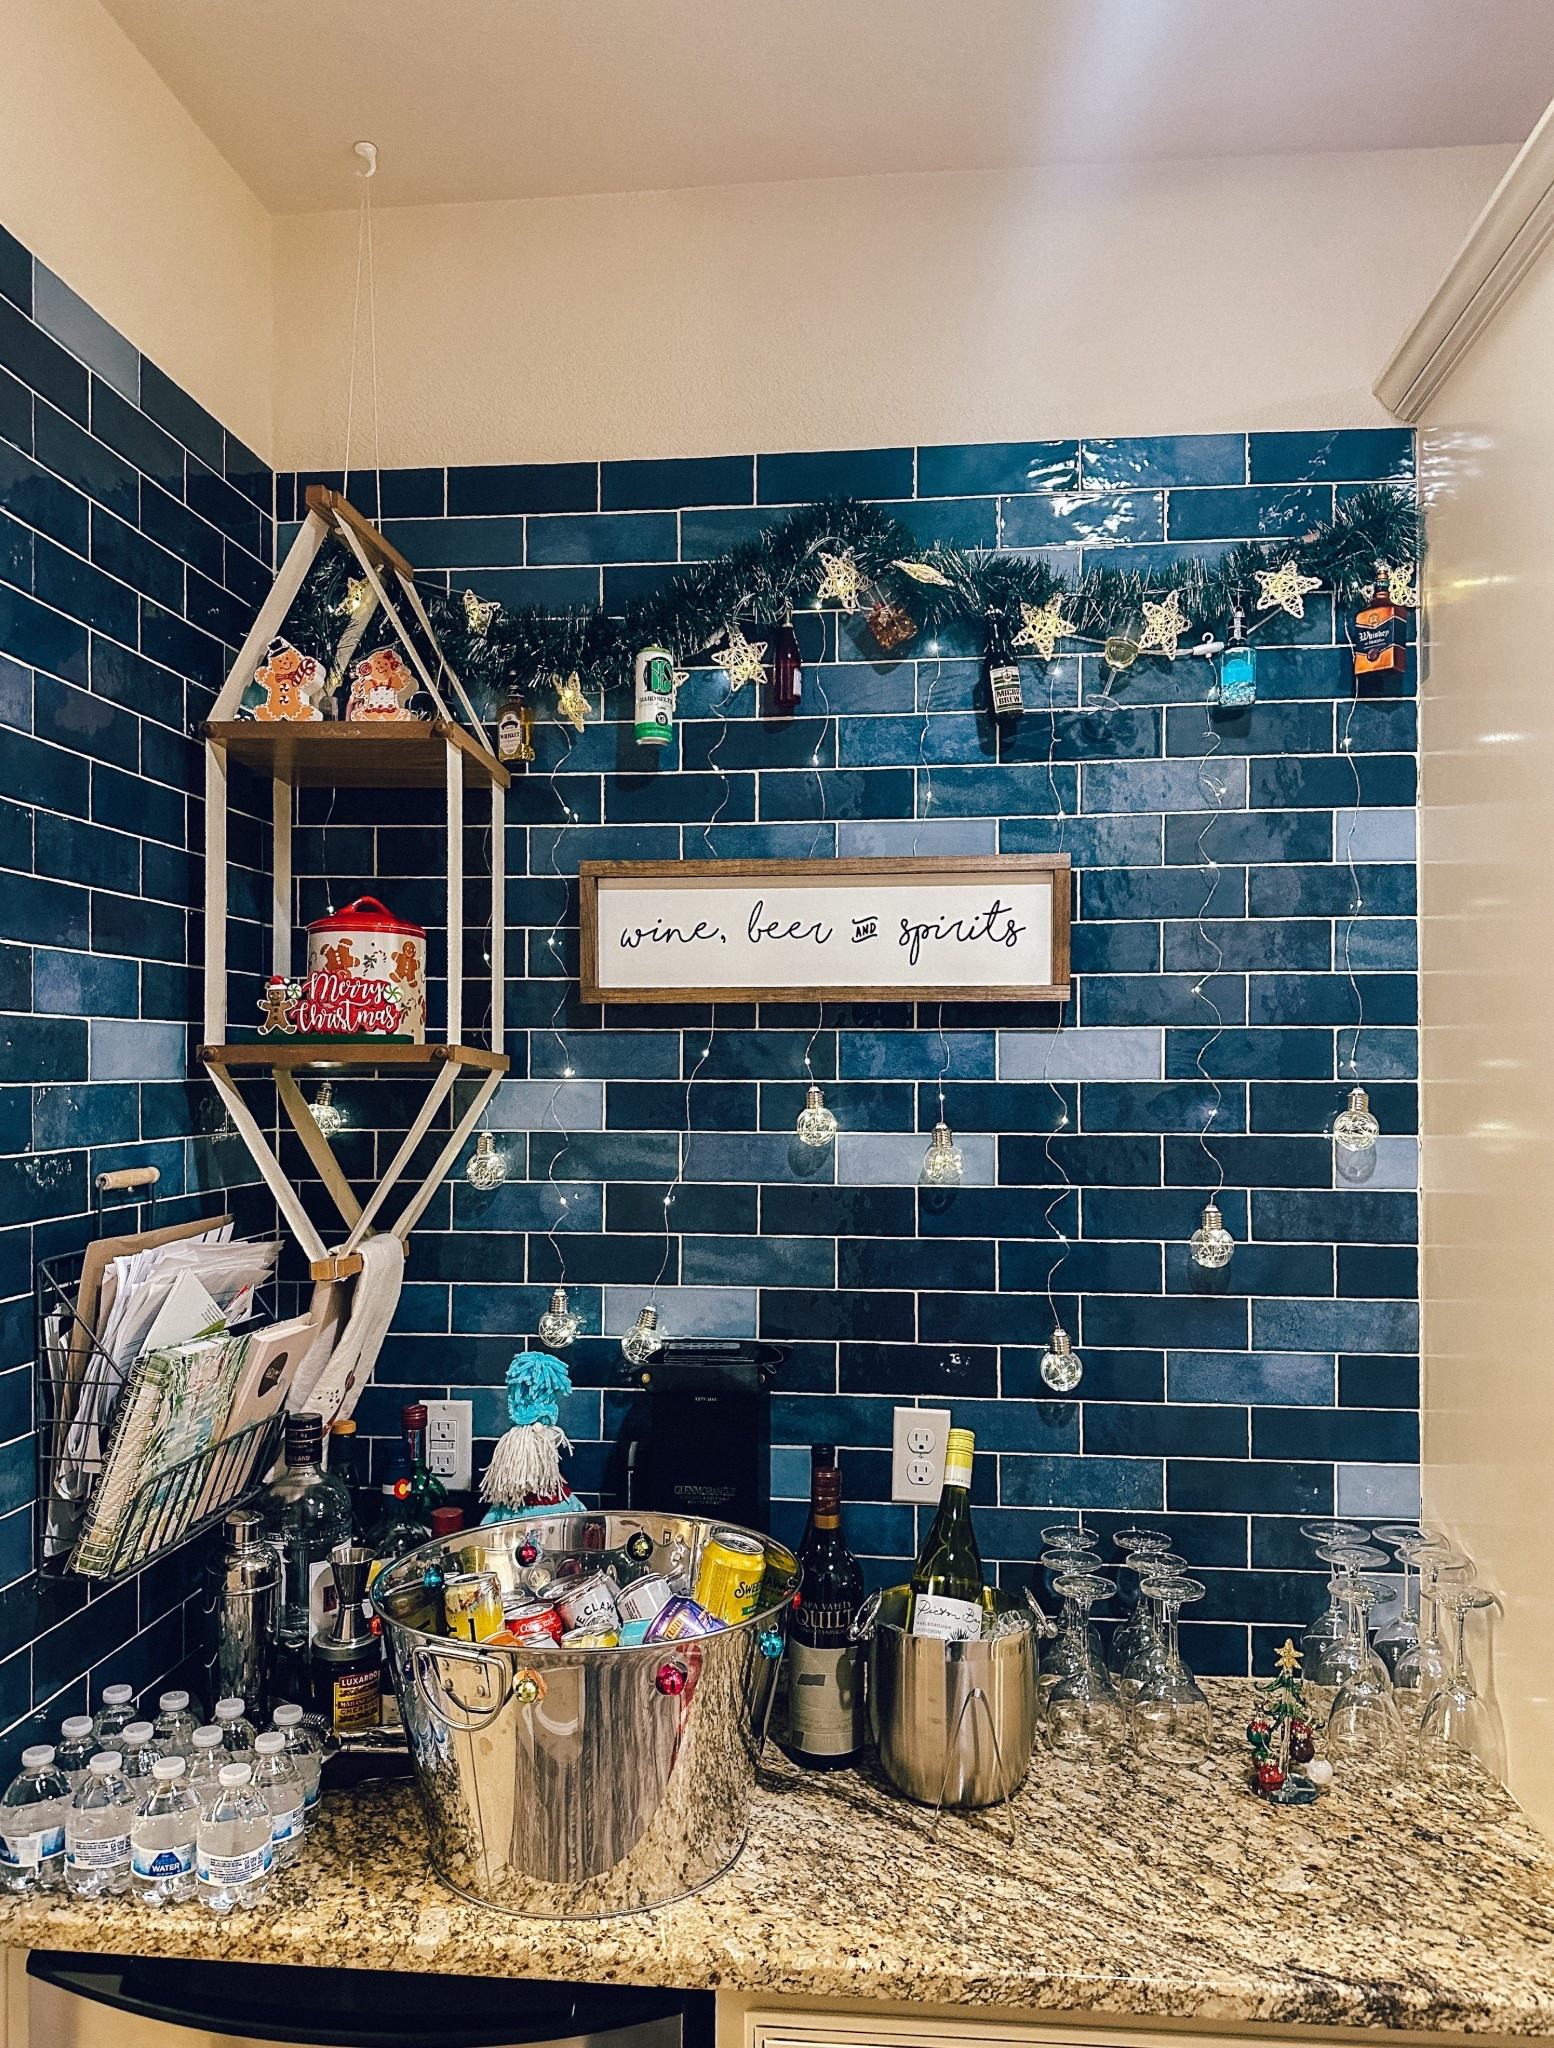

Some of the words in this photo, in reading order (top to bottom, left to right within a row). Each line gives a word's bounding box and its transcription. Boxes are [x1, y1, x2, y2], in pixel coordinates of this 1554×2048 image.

[1359, 629, 1390, 643] Whiskey
[998, 695, 1020, 704] BREW
[620, 919, 726, 949] wine,
[747, 900, 834, 944] beer
[854, 919, 877, 941] AND
[899, 899, 1027, 966] spirits
[302, 972, 385, 1003] Merry
[290, 998, 398, 1032] Christmas
[583, 1601, 614, 1616] CLAW
[795, 1606, 854, 1629] QUILT
[916, 1599, 961, 1619] Picton
[961, 1607, 981, 1634] Bay
[341, 1670, 378, 1687] LUXARDO
[151, 1862, 180, 1873] WATER
